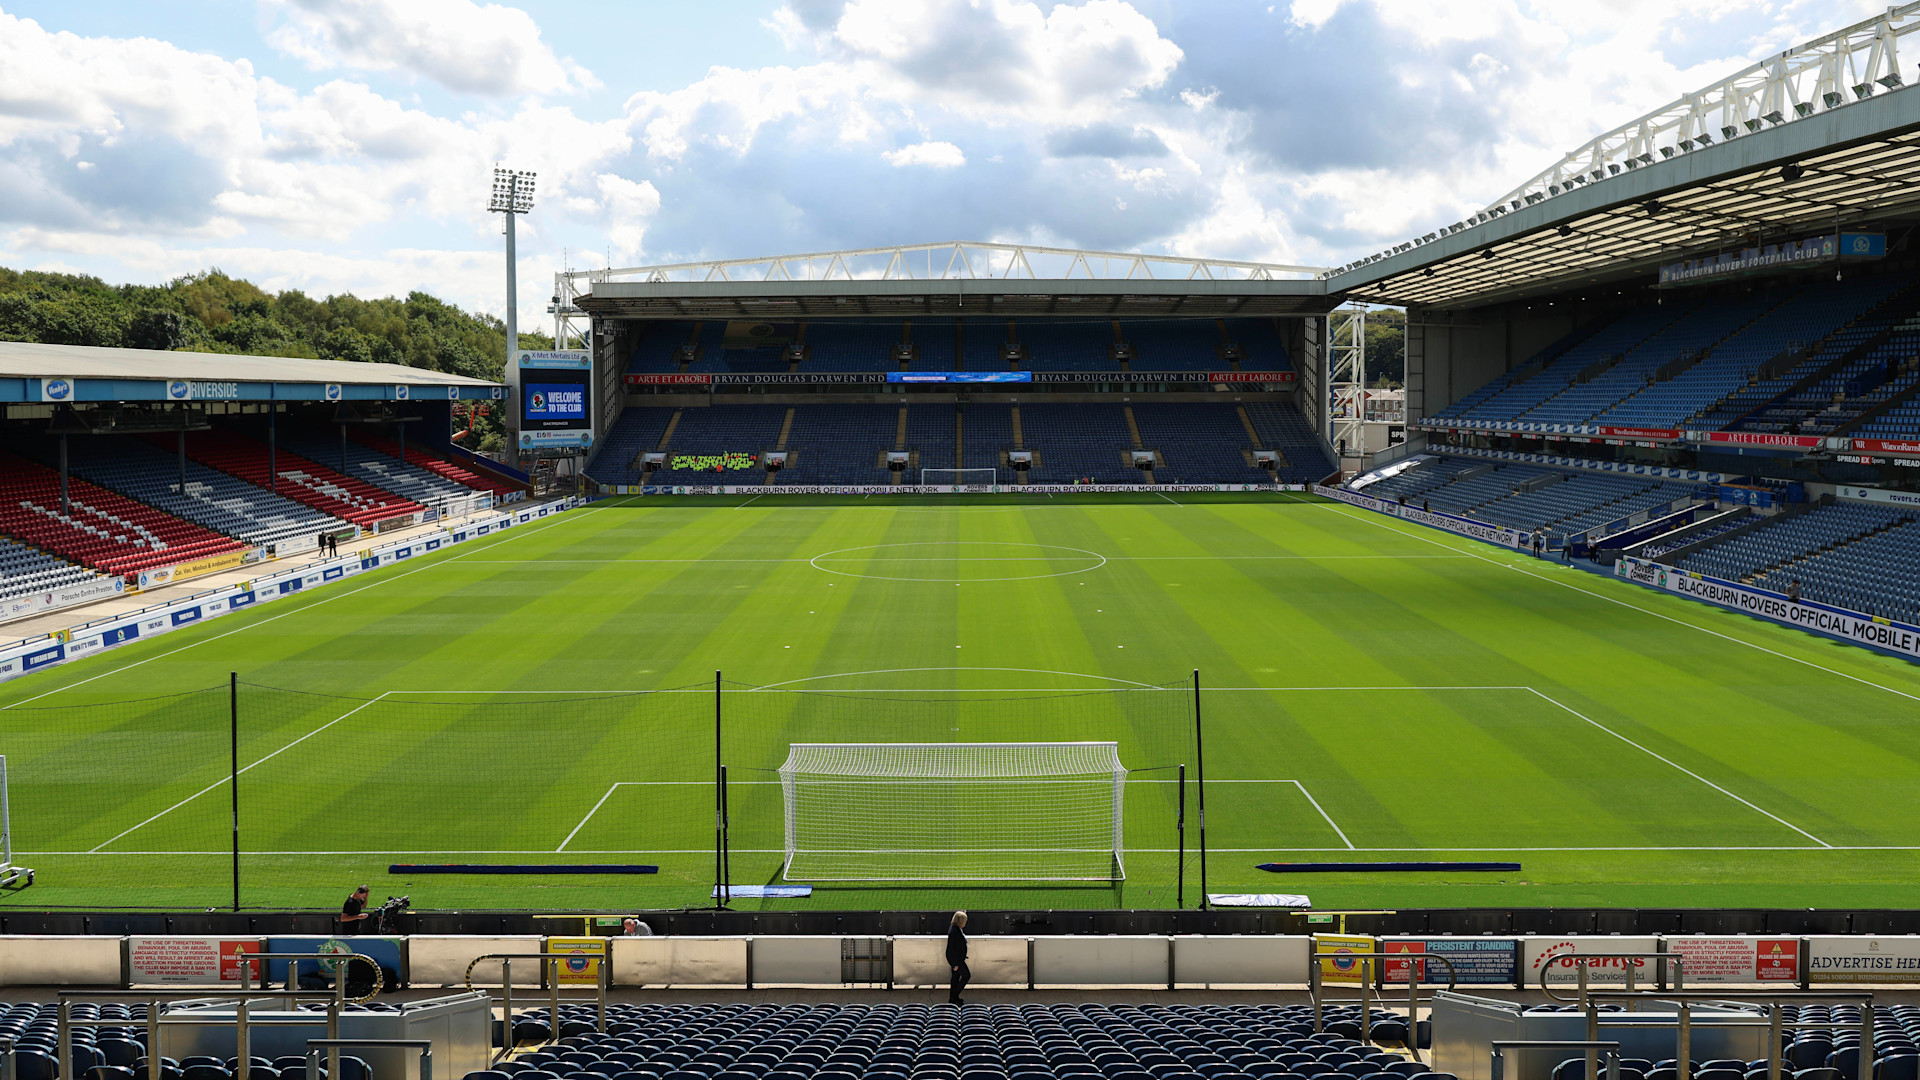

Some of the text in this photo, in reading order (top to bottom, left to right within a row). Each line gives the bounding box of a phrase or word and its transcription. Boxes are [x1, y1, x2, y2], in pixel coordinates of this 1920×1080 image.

[1672, 248, 1818, 281] BLACKBURN ROVERS FOOTBALL CLUB
[49, 384, 67, 394] Venky's
[192, 382, 238, 398] RIVERSIDE
[548, 392, 581, 402] WELCOME
[548, 404, 555, 412] TO
[557, 404, 567, 412] THE
[568, 404, 581, 412] CLUB
[1728, 434, 1798, 446] ARTE ET LABORE
[1405, 507, 1513, 545] BLACKBURN ROVERS OFFICIAL MOBILE NETWORK
[212, 559, 231, 568] Ambulance
[81, 589, 95, 597] Centre
[96, 586, 112, 594] Preston
[1678, 578, 1738, 604] BLACKBURN
[1741, 591, 1787, 618] ROVERS
[1790, 606, 1849, 634] OFFICIAL
[1853, 621, 1911, 650] MOBILE
[2, 664, 12, 672] PARK
[1427, 941, 1514, 950] PERSISTENT STANDING
[1811, 957, 1892, 968] ADVERTISE
[1592, 972, 1627, 980] Services
